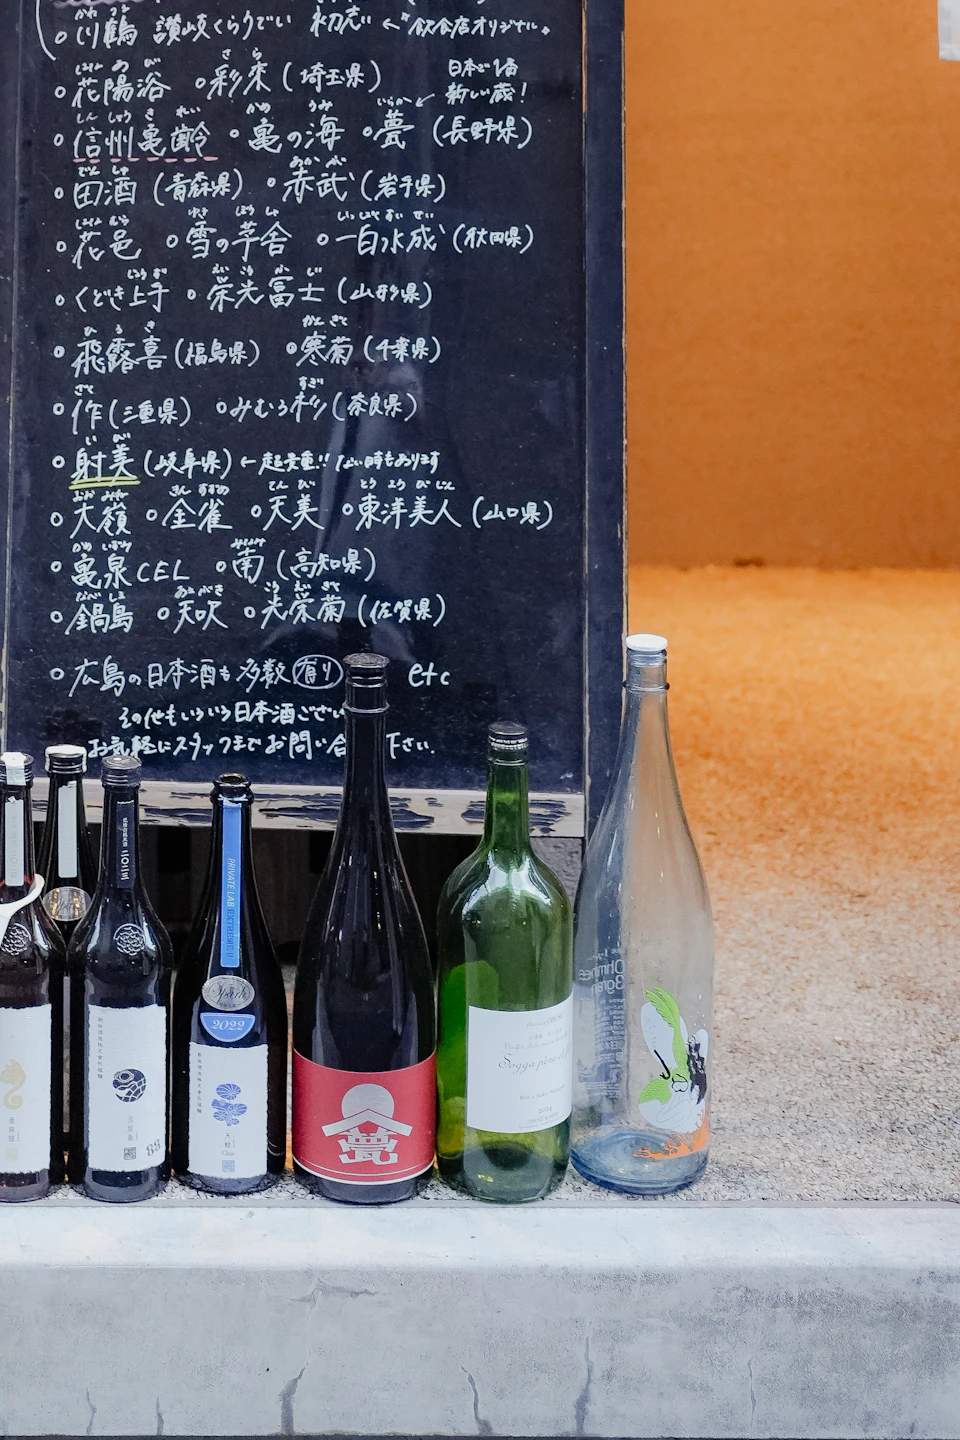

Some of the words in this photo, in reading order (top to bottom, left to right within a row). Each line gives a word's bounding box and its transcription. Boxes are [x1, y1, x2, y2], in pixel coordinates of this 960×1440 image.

[76, 15, 138, 49] 川鶴
[71, 71, 171, 108] 花陽浴
[282, 60, 381, 93] (埼玉県)
[73, 120, 211, 158] 信州亀齢
[247, 113, 345, 153] 亀の海
[432, 114, 533, 150] (長野県)
[73, 176, 137, 209] 田酒
[153, 168, 243, 207] (青森県)
[282, 167, 355, 204] 赤武
[361, 169, 446, 203] (岩手県)
[72, 229, 142, 269] 花邑
[186, 220, 292, 262] 雪の茅舎
[335, 223, 446, 256] 一白水成
[452, 223, 534, 255] (秋田県)
[75, 281, 170, 313] くどき上手
[337, 276, 433, 309] (山形県)
[71, 334, 168, 378] 飛露喜
[174, 337, 260, 370] (福島県)
[296, 331, 354, 367] 寒菊
[363, 334, 441, 364] (千葉県)
[71, 398, 104, 435] 作
[108, 396, 191, 430] (三重県)
[229, 391, 328, 423] みむろ杉
[332, 391, 417, 422] (奈良県)
[70, 443, 138, 486] 射美
[144, 447, 233, 479] (岐阜県)
[70, 502, 131, 539] 大嶺
[162, 497, 233, 533] 金雀
[262, 493, 325, 531] 天美
[355, 493, 462, 531] 東洋美人
[472, 495, 553, 530] (山口県)
[71, 552, 132, 590] 亀泉
[136, 559, 190, 583] CEL
[232, 547, 265, 584] 南
[277, 547, 376, 582] (高知県)
[64, 601, 134, 635] 鍋島
[173, 600, 228, 634] 天吹
[261, 591, 346, 630] 光栄菊
[358, 593, 446, 628] (佐賀県)
[408, 661, 451, 687] etc
[227, 858, 236, 890] PRIVATE
[226, 891, 235, 907] LAB
[226, 910, 235, 950] EXTREME
[210, 980, 251, 1004] Spark
[211, 1019, 246, 1032] 2022
[498, 1052, 536, 1075] Sogga
